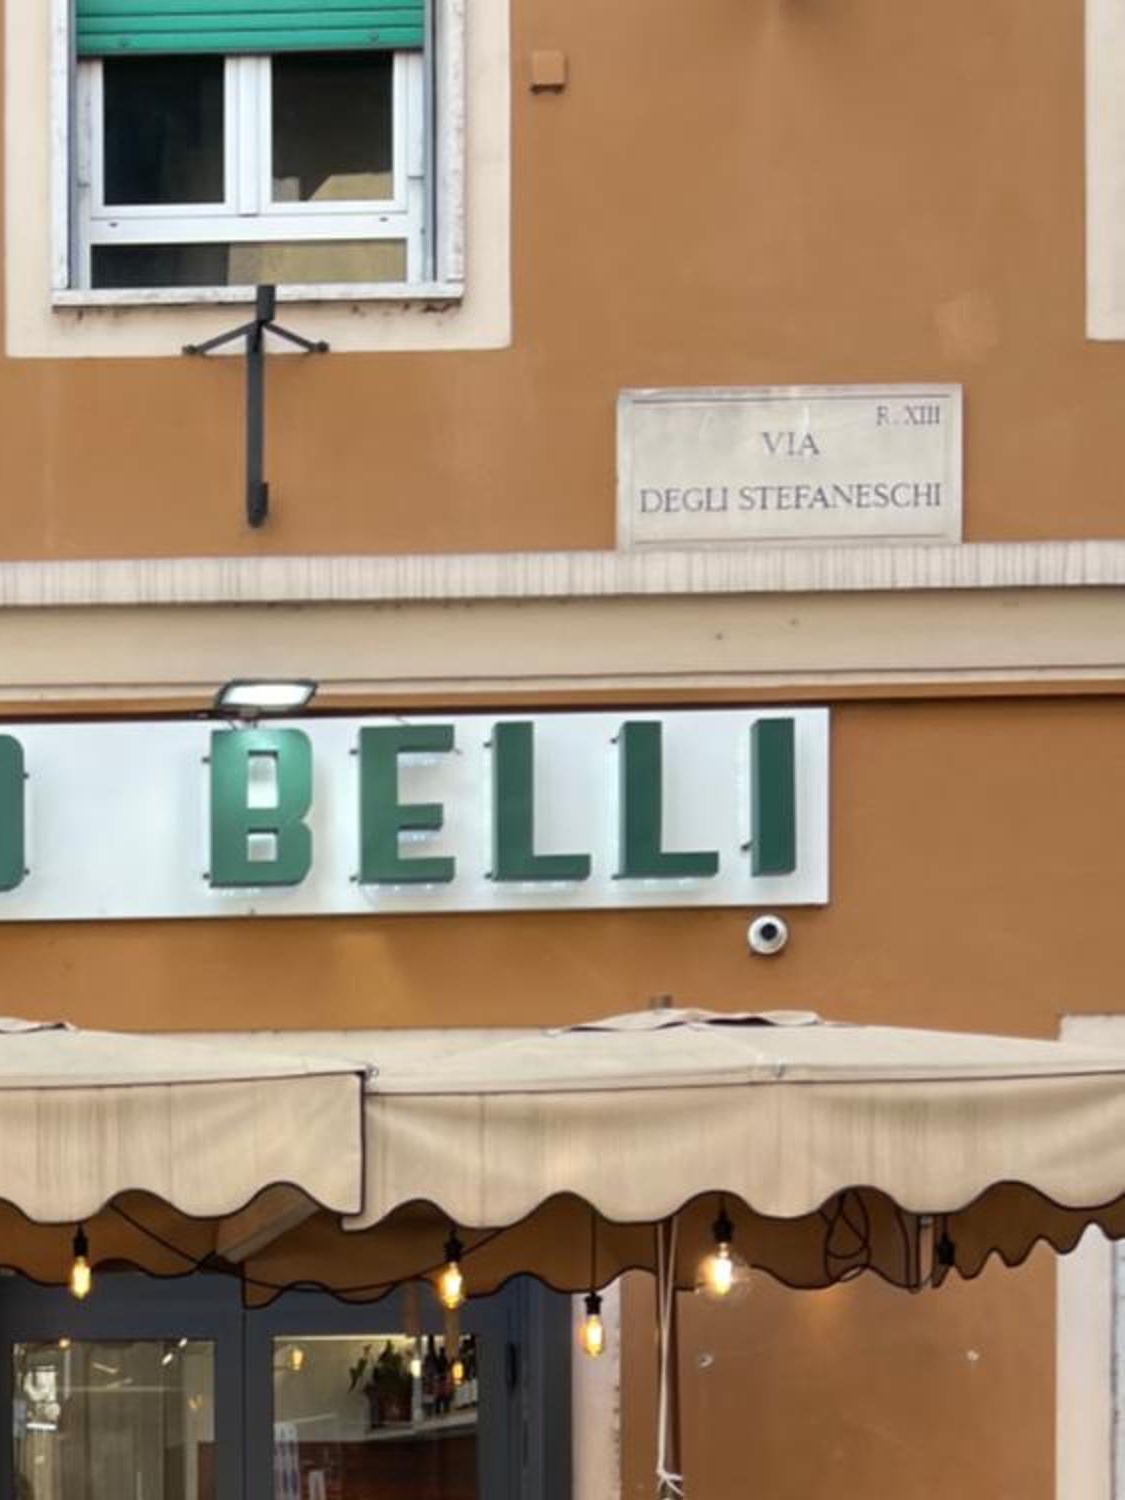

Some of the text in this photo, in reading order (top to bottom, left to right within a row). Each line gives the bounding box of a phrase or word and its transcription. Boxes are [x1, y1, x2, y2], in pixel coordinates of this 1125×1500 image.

[904, 404, 940, 424] XIII
[762, 431, 820, 456] VIA
[640, 483, 941, 512] DEGLI STEFANESCHI
[207, 717, 797, 887] BELLI
